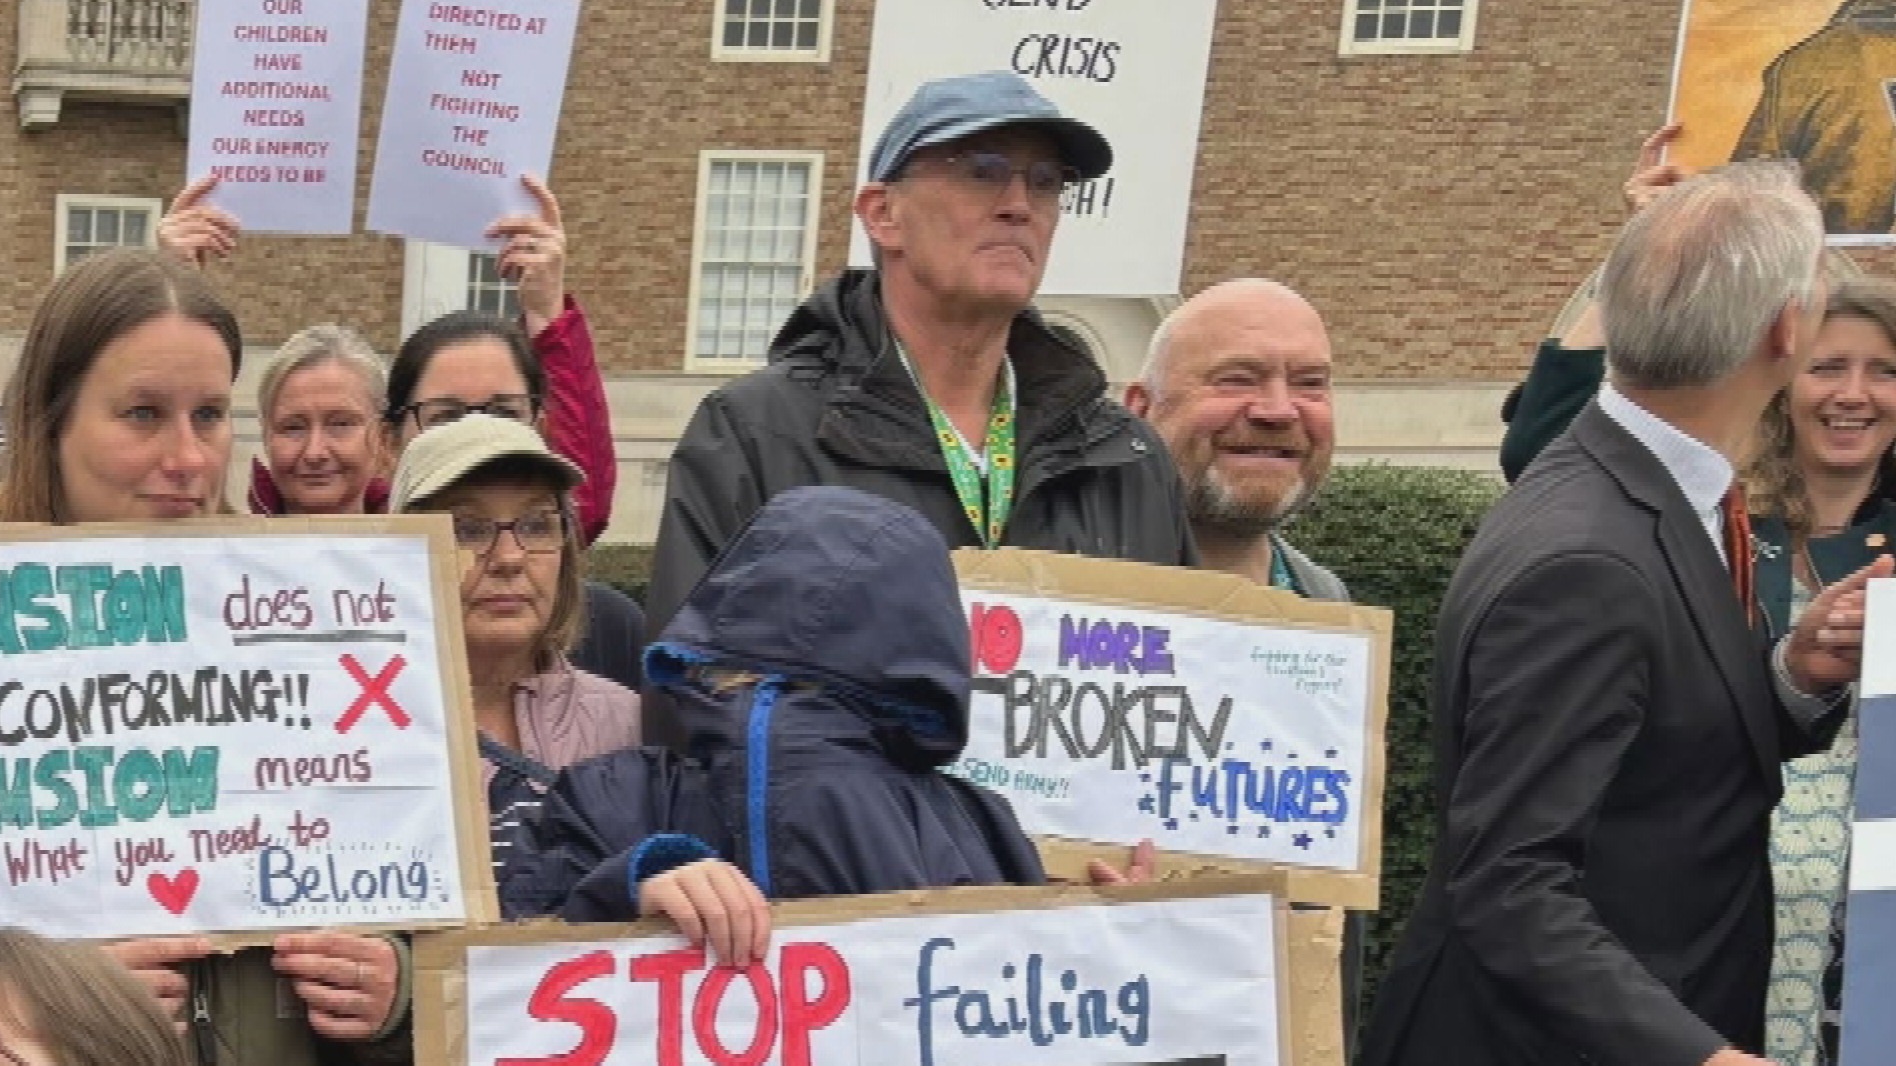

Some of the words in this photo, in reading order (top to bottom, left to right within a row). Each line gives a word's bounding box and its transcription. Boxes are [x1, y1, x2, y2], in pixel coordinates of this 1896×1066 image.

[428, 2, 522, 31] DIRECTED
[524, 17, 547, 35] AT
[234, 25, 328, 43] CHILDREN
[424, 29, 477, 55] THEM
[254, 53, 302, 71] HAVE
[1011, 33, 1121, 82] CRISIS
[221, 81, 331, 100] ADDITIONAL
[461, 69, 503, 90] NOT
[244, 109, 305, 127] NEEDS
[430, 93, 519, 122] FIGHTING
[212, 137, 251, 155] OUR
[256, 138, 330, 159] ENERGY
[452, 125, 489, 146] THE
[275, 165, 299, 183] TO
[422, 149, 507, 178] COUNCIL
[223, 575, 313, 632] does
[333, 579, 396, 626] not
[1058, 614, 1175, 677] MORE
[1004, 669, 1234, 771] BROKEN
[255, 748, 372, 790] means
[115, 837, 174, 887] you
[188, 813, 271, 862] need
[288, 810, 330, 847] to
